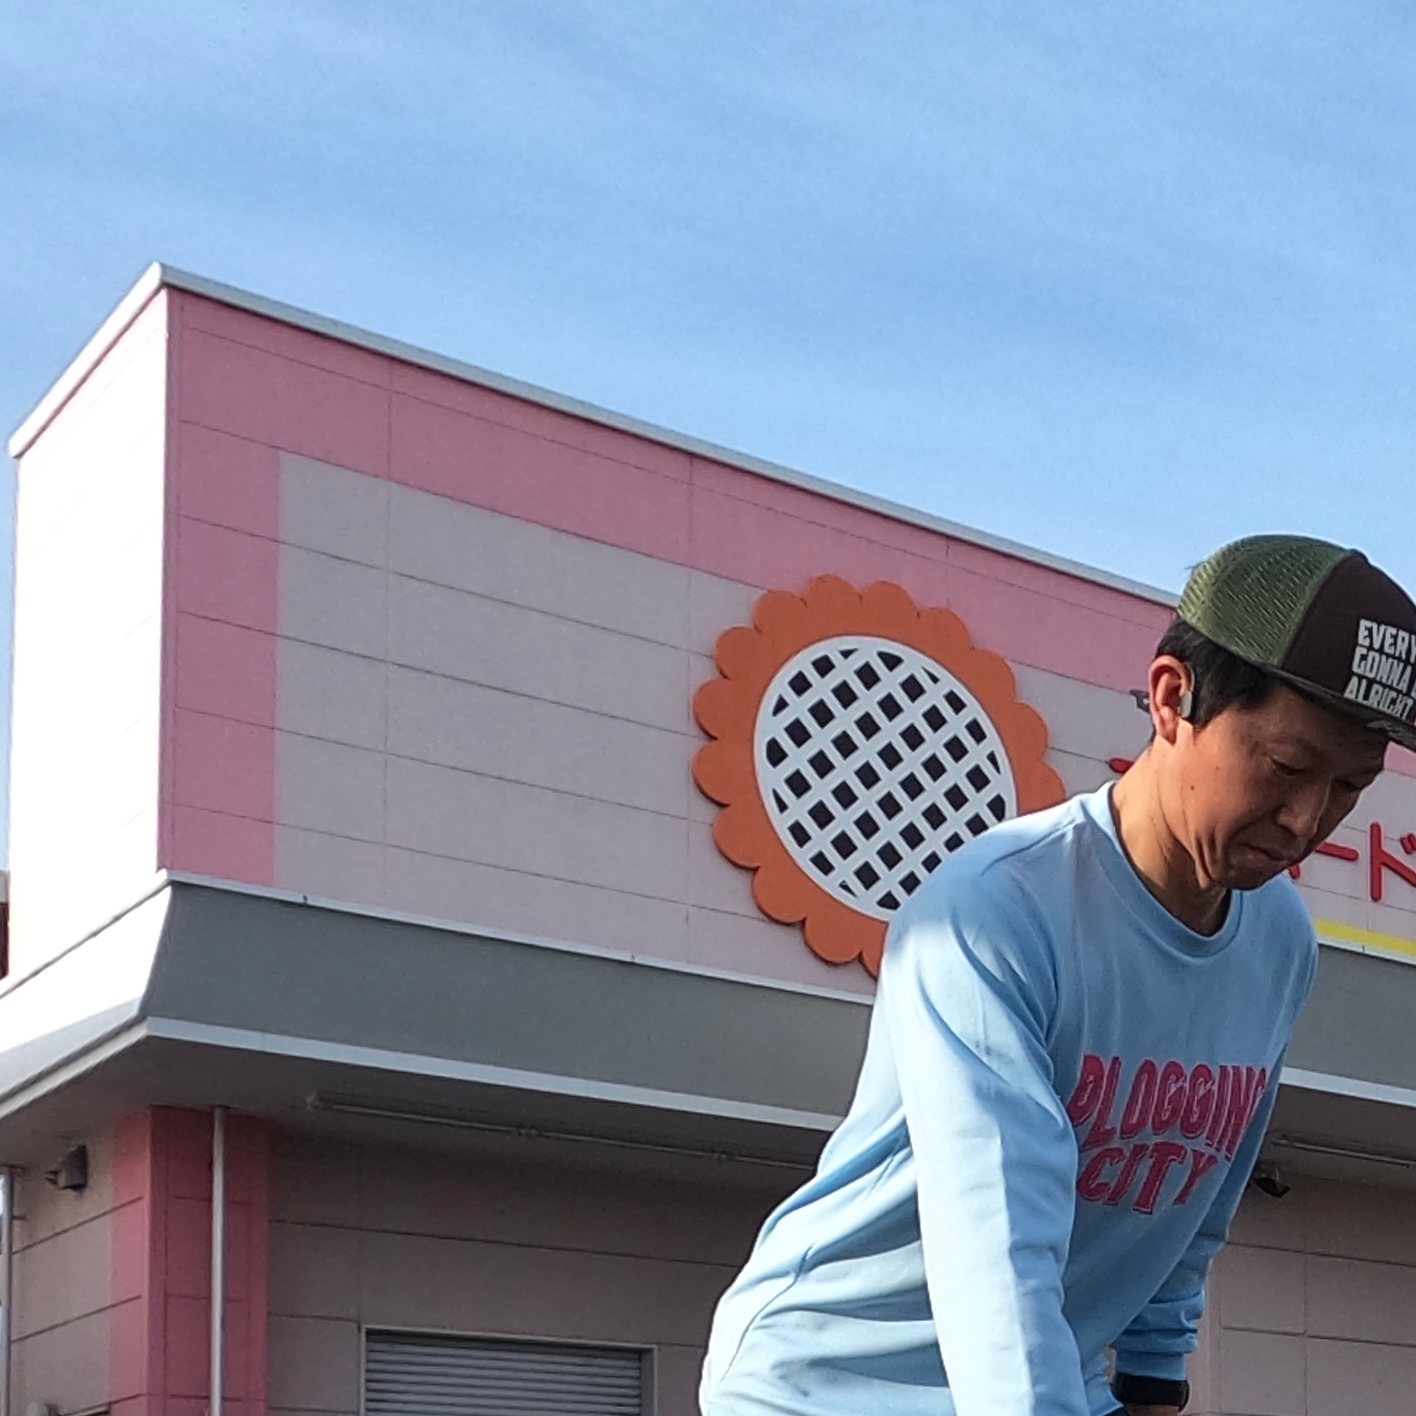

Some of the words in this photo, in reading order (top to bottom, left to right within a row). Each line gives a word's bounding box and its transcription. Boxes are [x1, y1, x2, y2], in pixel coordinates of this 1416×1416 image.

[1351, 645, 1413, 694] GONNA
[1343, 674, 1415, 720] ALRIGHT
[1077, 1141, 1218, 1215] CITY
